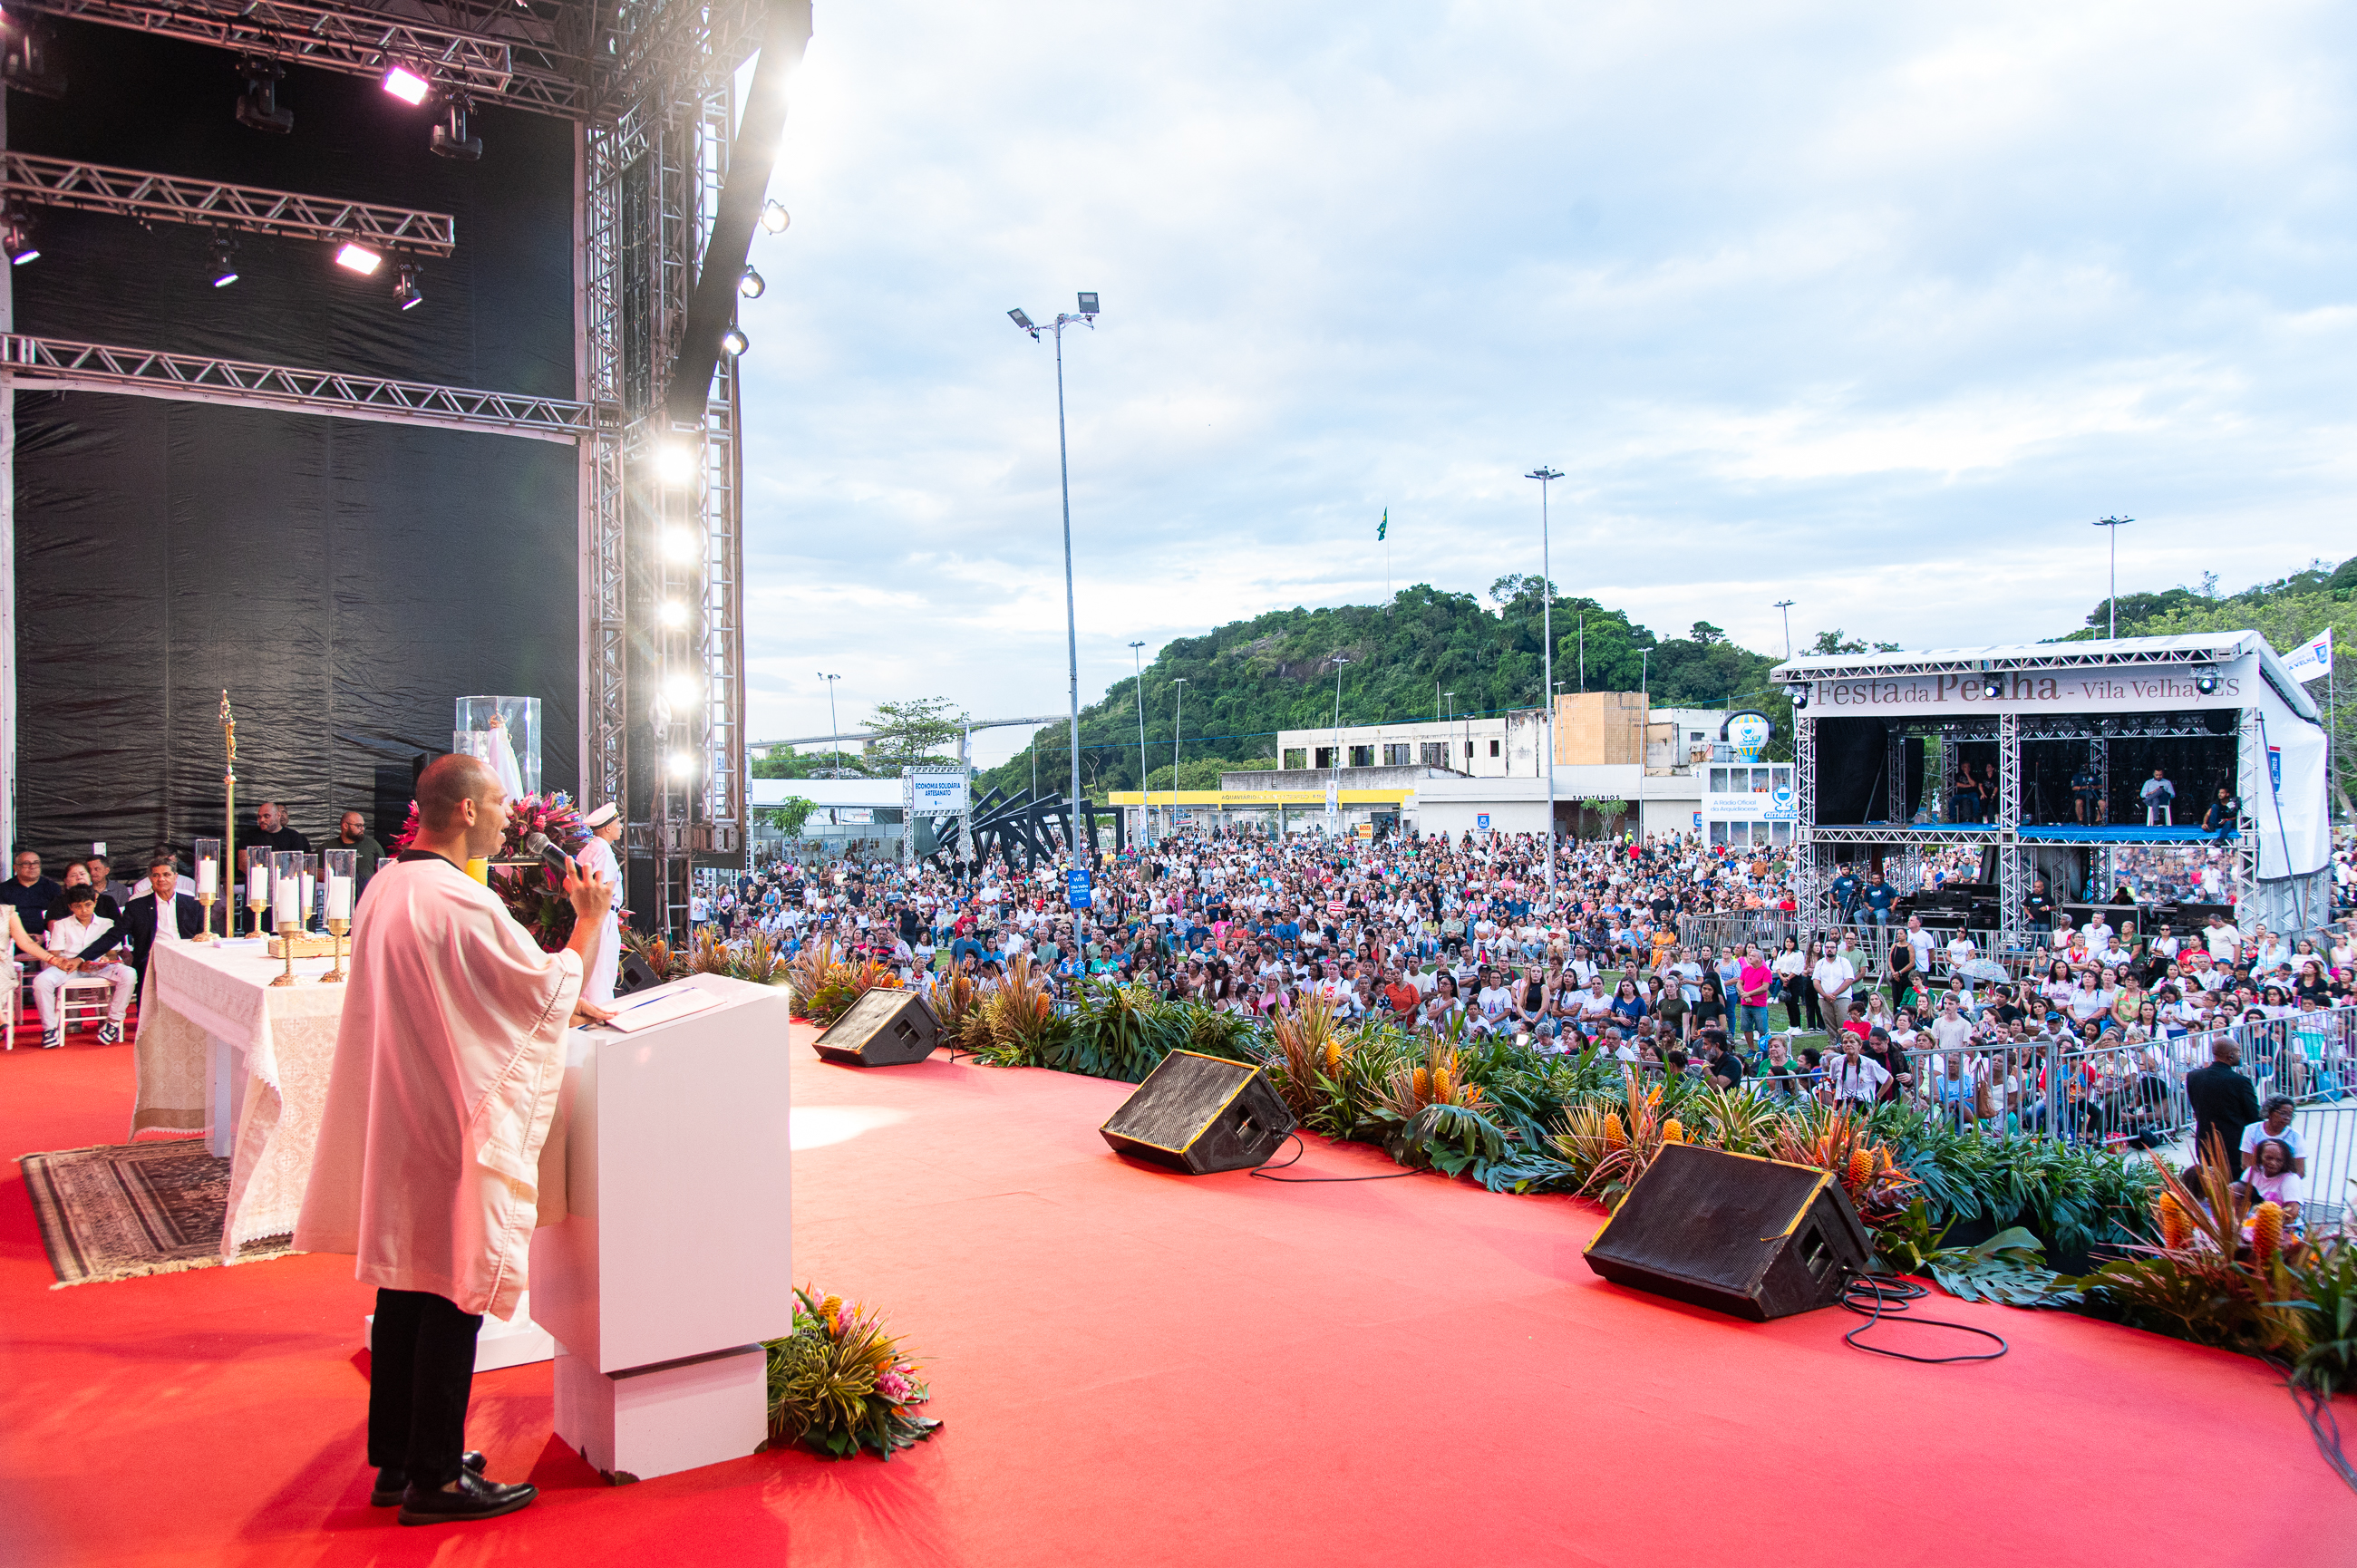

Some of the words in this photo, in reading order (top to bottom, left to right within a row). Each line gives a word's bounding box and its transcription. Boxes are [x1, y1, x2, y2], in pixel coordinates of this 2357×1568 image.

[1814, 679, 1902, 705] Festa
[1905, 682, 1931, 702] da
[2081, 680, 2126, 700] Vila
[938, 780, 961, 789] SOLIDÁRIA
[1764, 810, 1798, 819] améric
